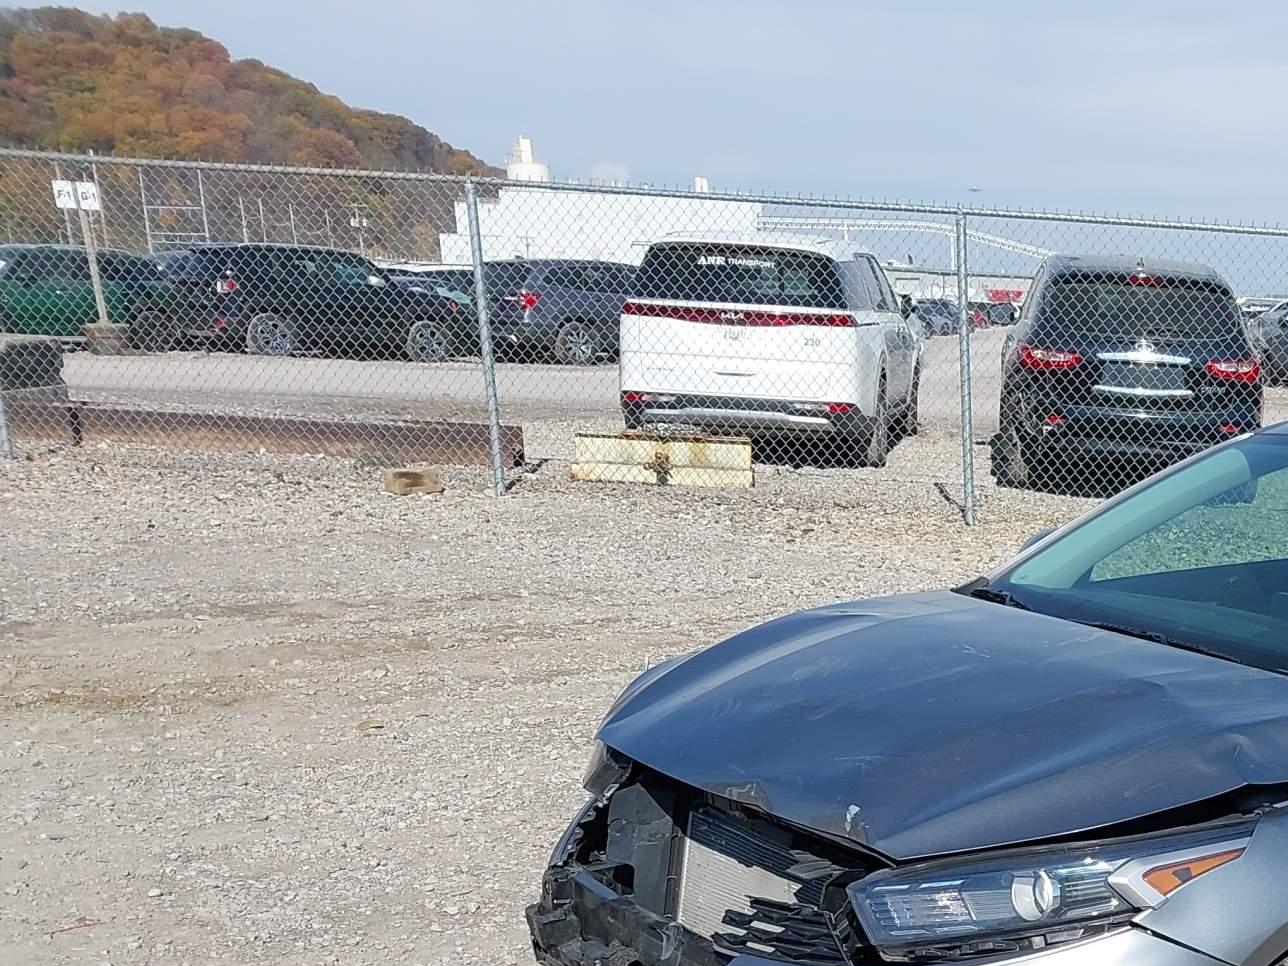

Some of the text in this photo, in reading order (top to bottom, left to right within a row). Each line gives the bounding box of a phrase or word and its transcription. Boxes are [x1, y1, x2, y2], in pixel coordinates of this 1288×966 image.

[81, 191, 97, 202] G-1
[698, 256, 776, 269] ANR TRANSPORT
[804, 338, 821, 347] 230
